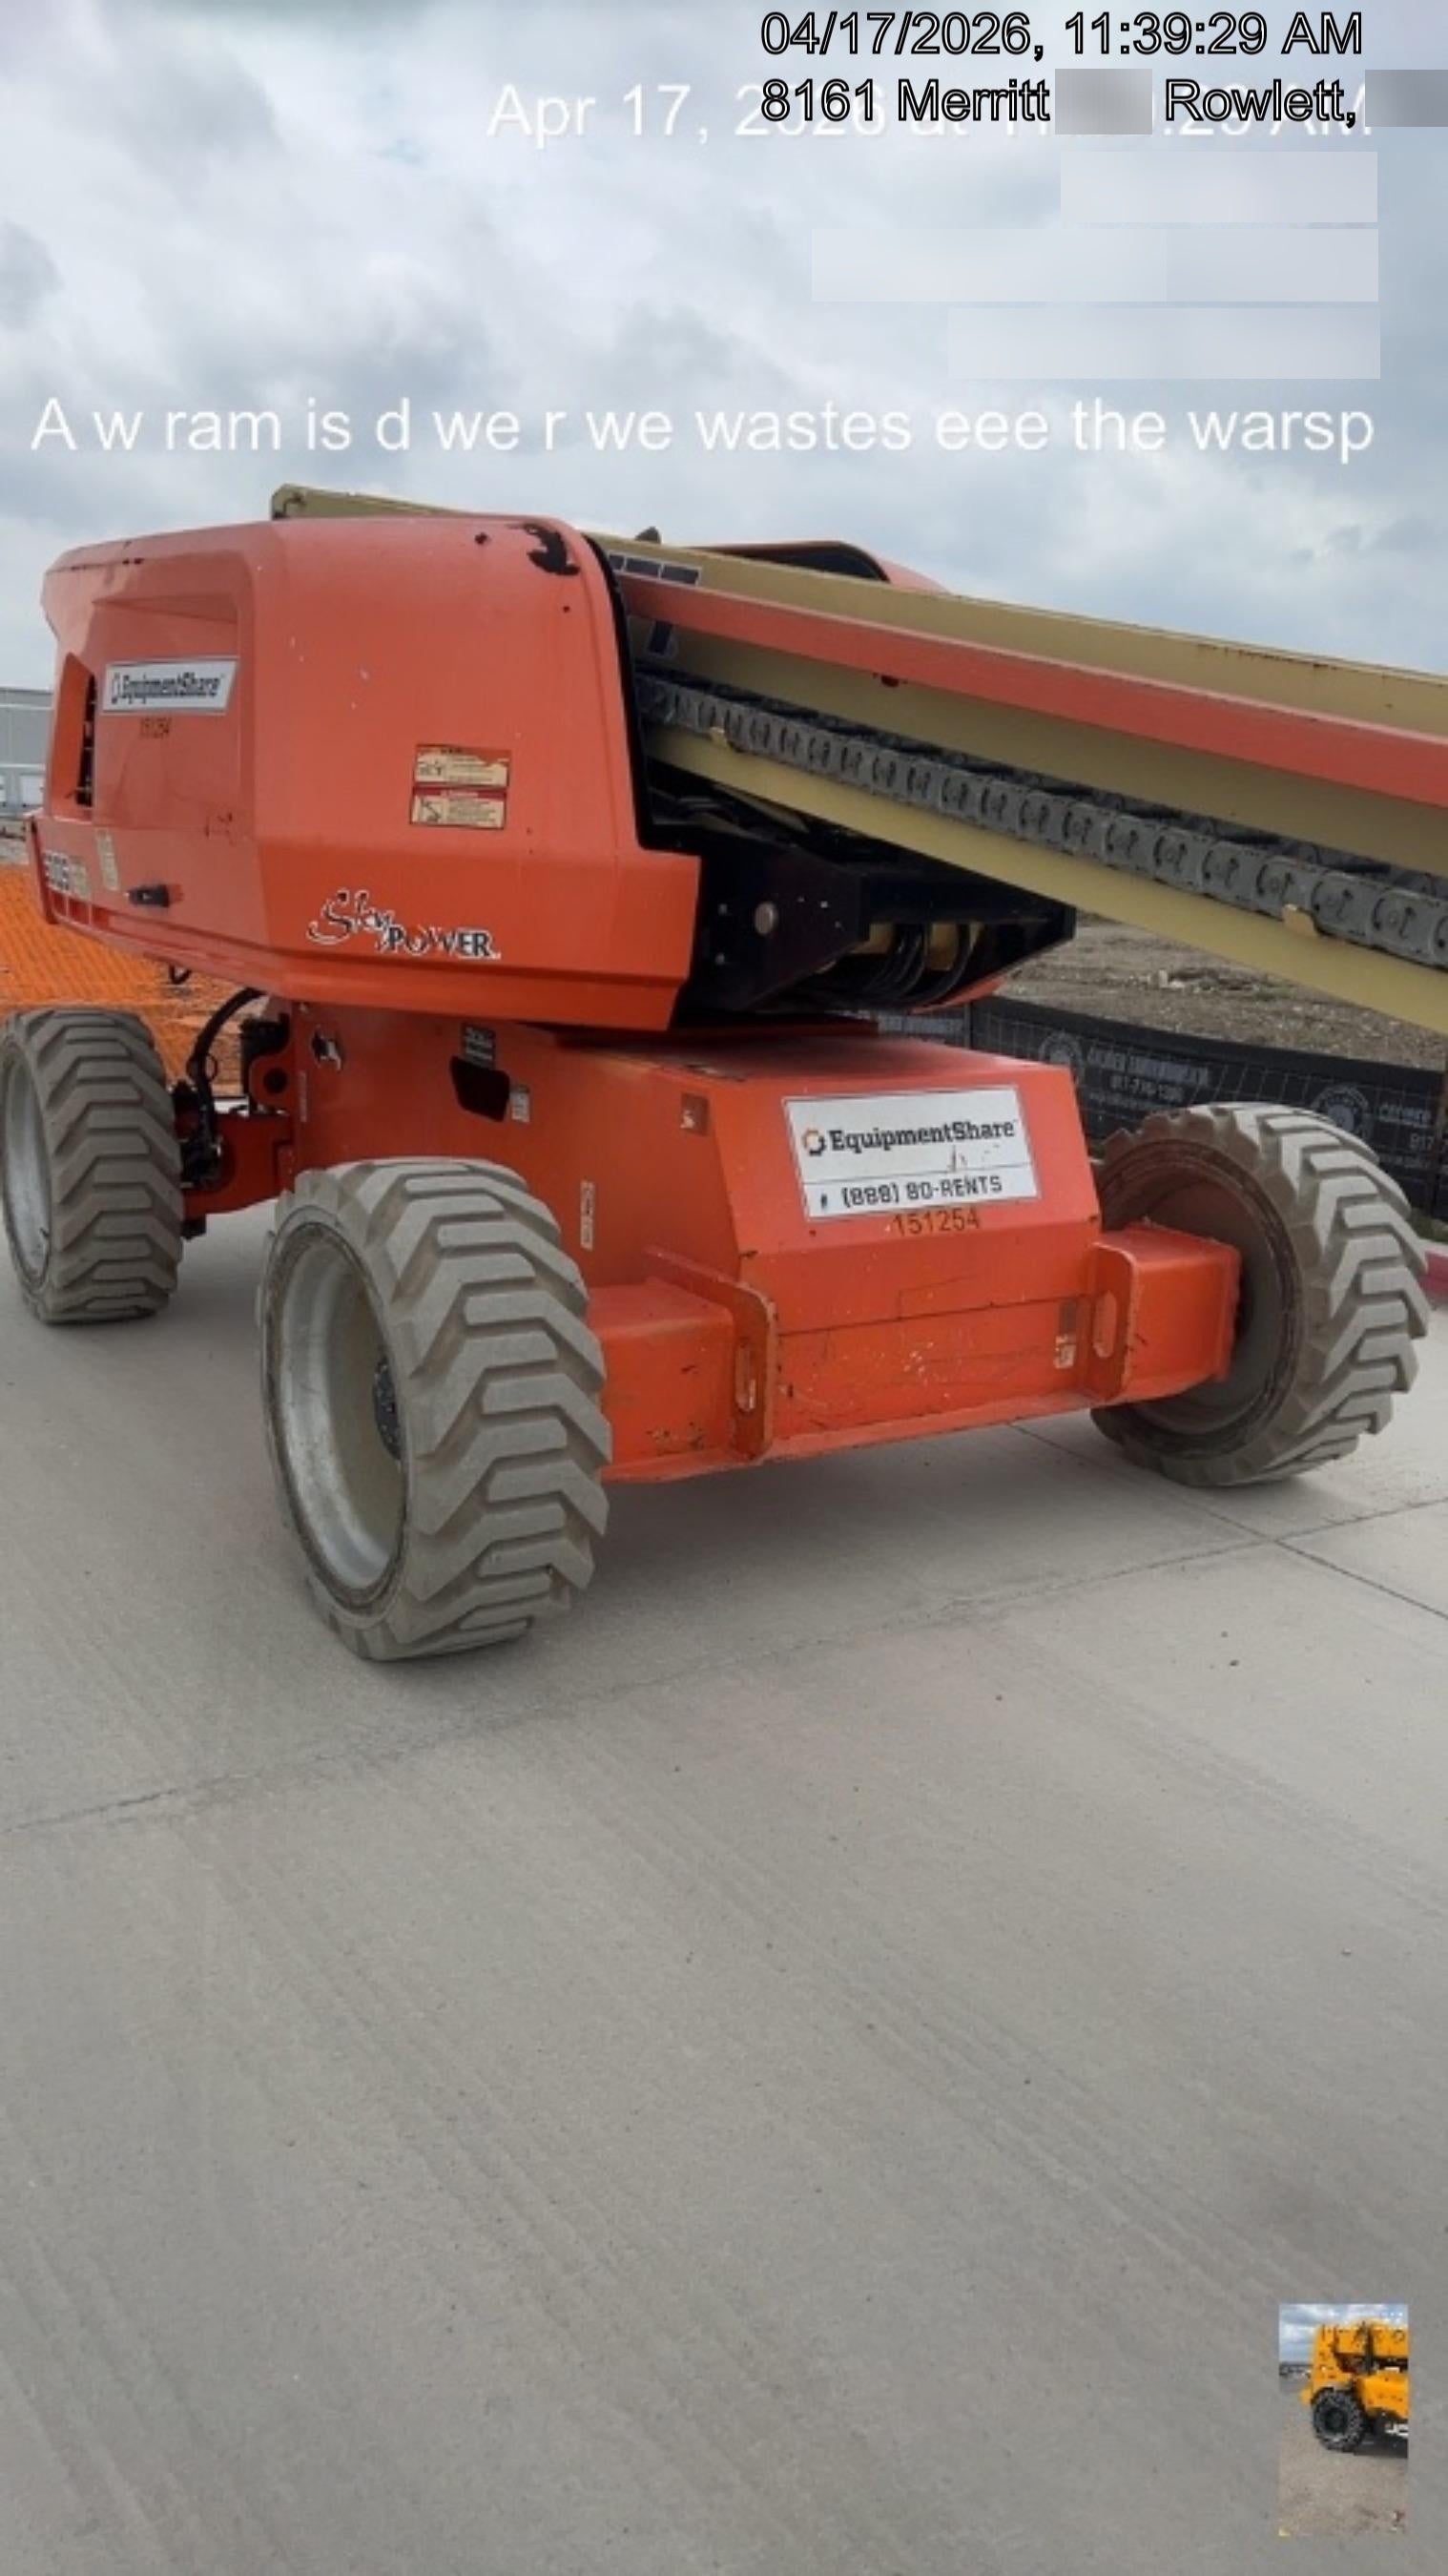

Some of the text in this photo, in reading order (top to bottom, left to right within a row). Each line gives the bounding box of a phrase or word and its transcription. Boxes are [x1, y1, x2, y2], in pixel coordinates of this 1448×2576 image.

[121, 671, 221, 705] EquipmentShare
[827, 1120, 1016, 1153] EquipmentShare
[841, 1174, 1003, 1209] (888) 80-RENTS
[891, 1205, 982, 1238] 151254
